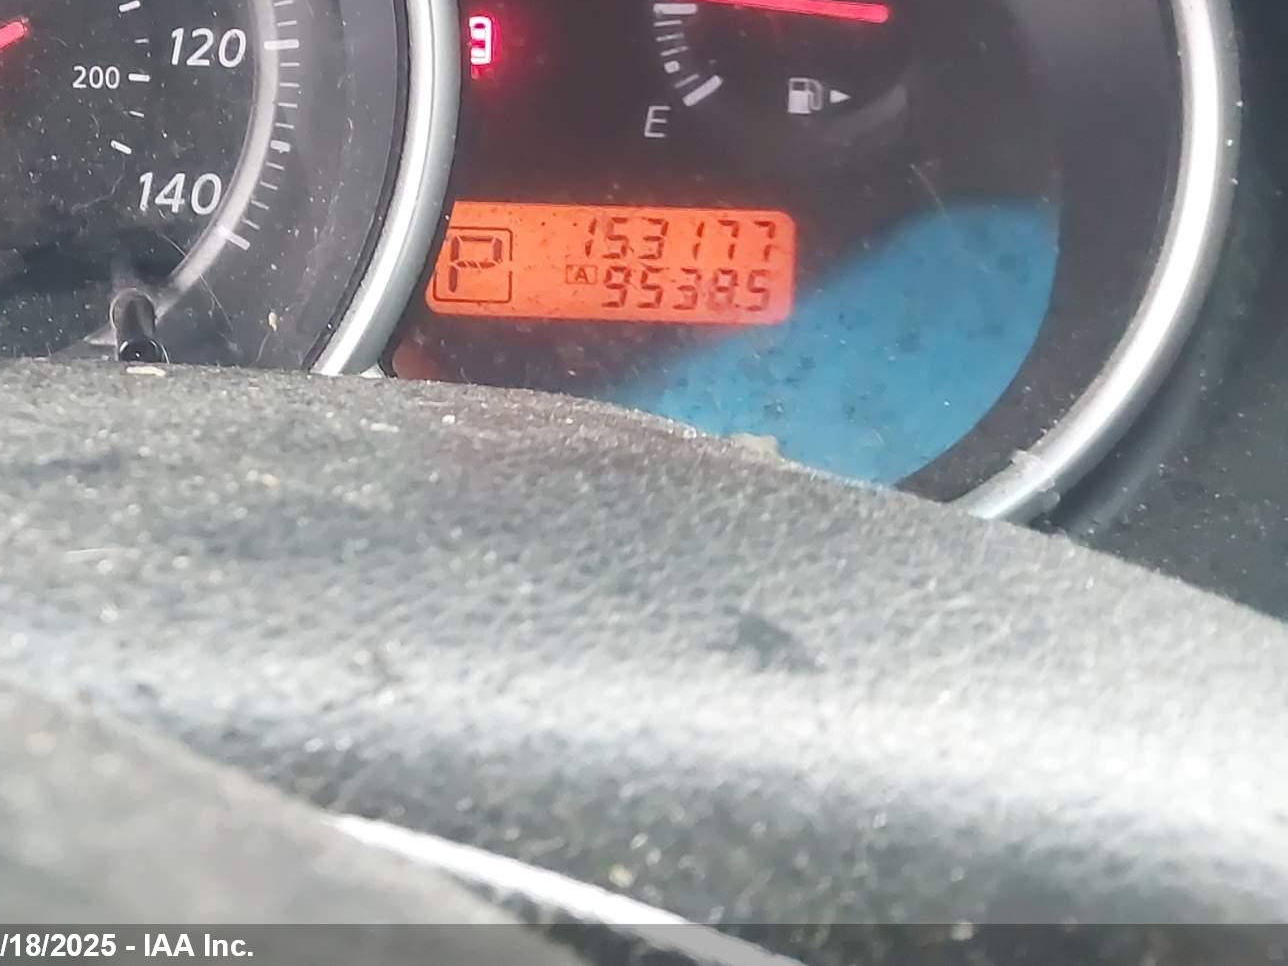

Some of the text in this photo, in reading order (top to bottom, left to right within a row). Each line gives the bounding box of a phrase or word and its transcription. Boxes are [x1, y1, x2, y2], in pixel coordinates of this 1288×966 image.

[170, 28, 246, 67] 120
[72, 66, 120, 88] 200
[644, 105, 671, 138] E
[138, 173, 222, 215] 140
[585, 217, 776, 261] 153177
[449, 234, 503, 293] P
